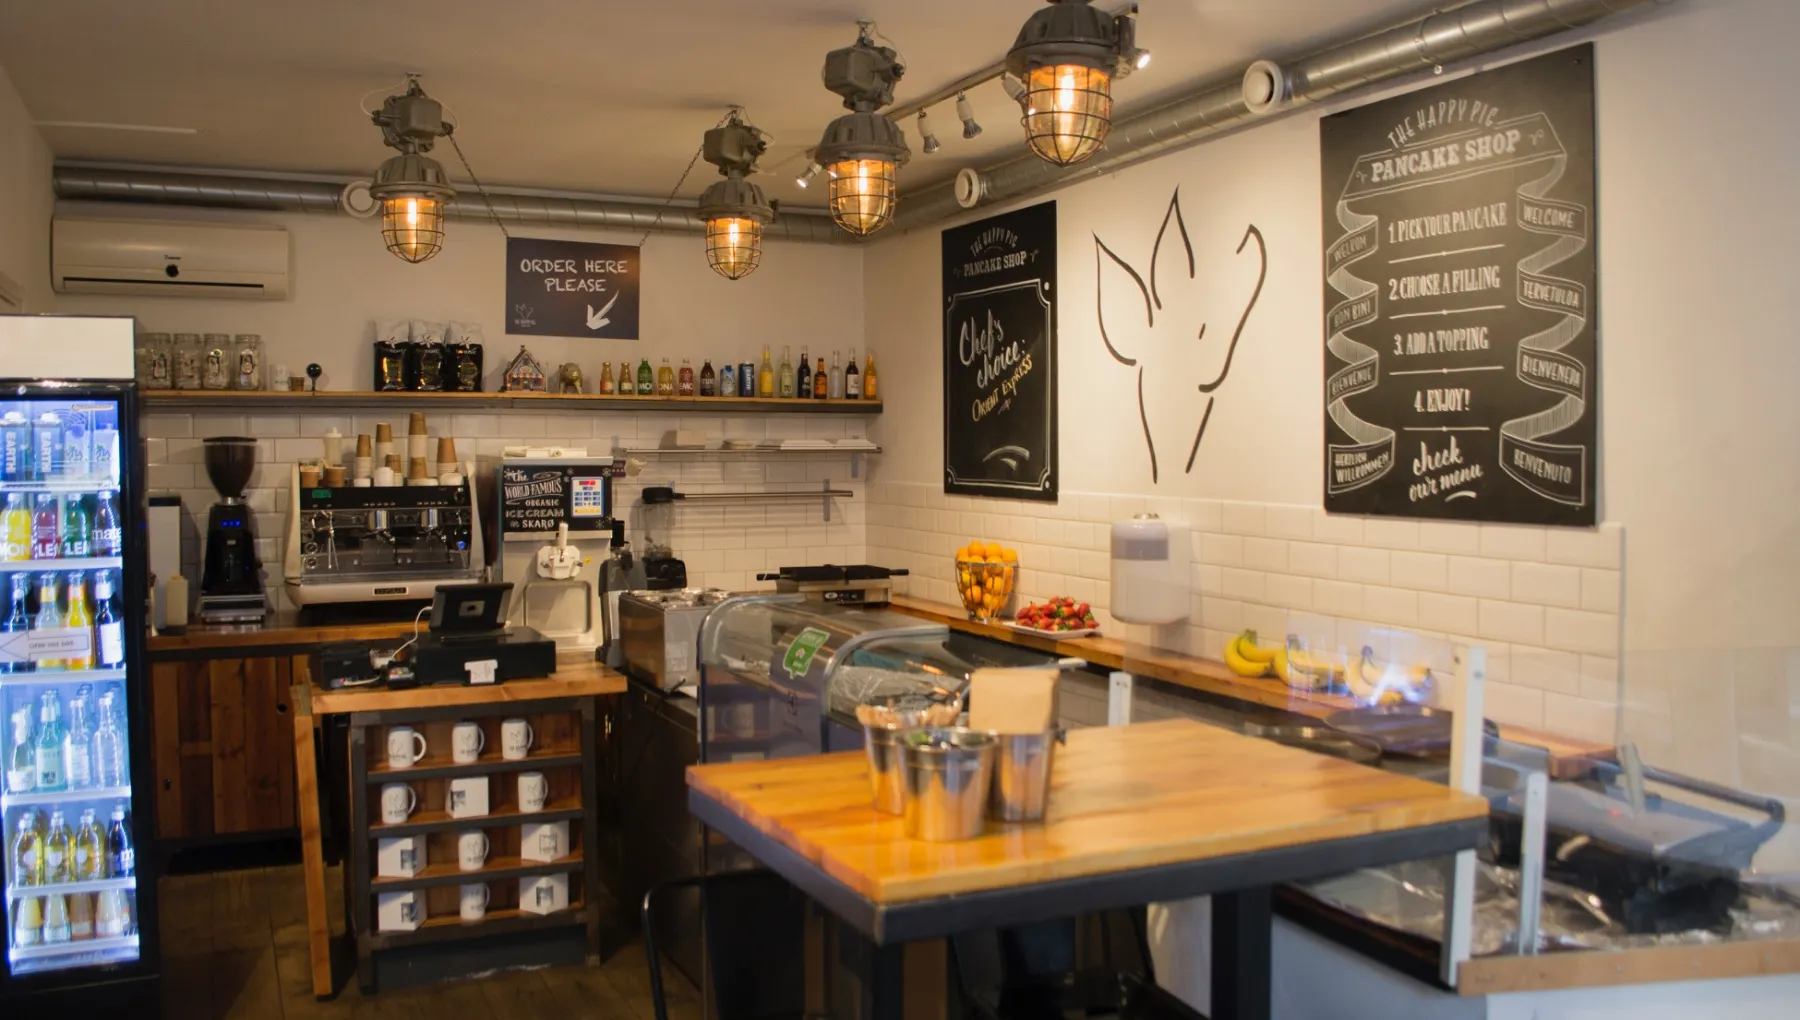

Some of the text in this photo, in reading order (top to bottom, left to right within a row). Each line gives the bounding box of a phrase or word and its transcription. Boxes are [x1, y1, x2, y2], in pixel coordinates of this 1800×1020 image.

[1387, 98, 1499, 149] THE HAPPY PIG
[1371, 129, 1520, 183] PANCAKE SHOP
[1397, 217, 1424, 242] PICK
[1422, 213, 1451, 237] YOUR
[1452, 202, 1507, 233] PANCAKE
[1523, 203, 1575, 228] WELCOME
[970, 227, 1018, 257] THE HAPPY PIG
[520, 259, 628, 274] ORDER HERE
[964, 250, 1027, 276] PANCAKE SHOP
[544, 278, 607, 292] PLEASE
[1399, 273, 1440, 299] CHOOSE
[1441, 272, 1450, 294] A
[1452, 265, 1501, 294] FILLING
[959, 309, 1004, 367] Chef's
[1406, 332, 1426, 355] ADD
[1427, 331, 1436, 354] A
[1436, 326, 1490, 353] TOPPING
[1427, 387, 1471, 412] ENJOY!
[1412, 435, 1464, 476] check
[504, 478, 563, 499] WORLD FAMOUS
[1409, 463, 1484, 502] our menu
[505, 508, 565, 518] ICE CREAM
[525, 499, 560, 507] ORGANIC
